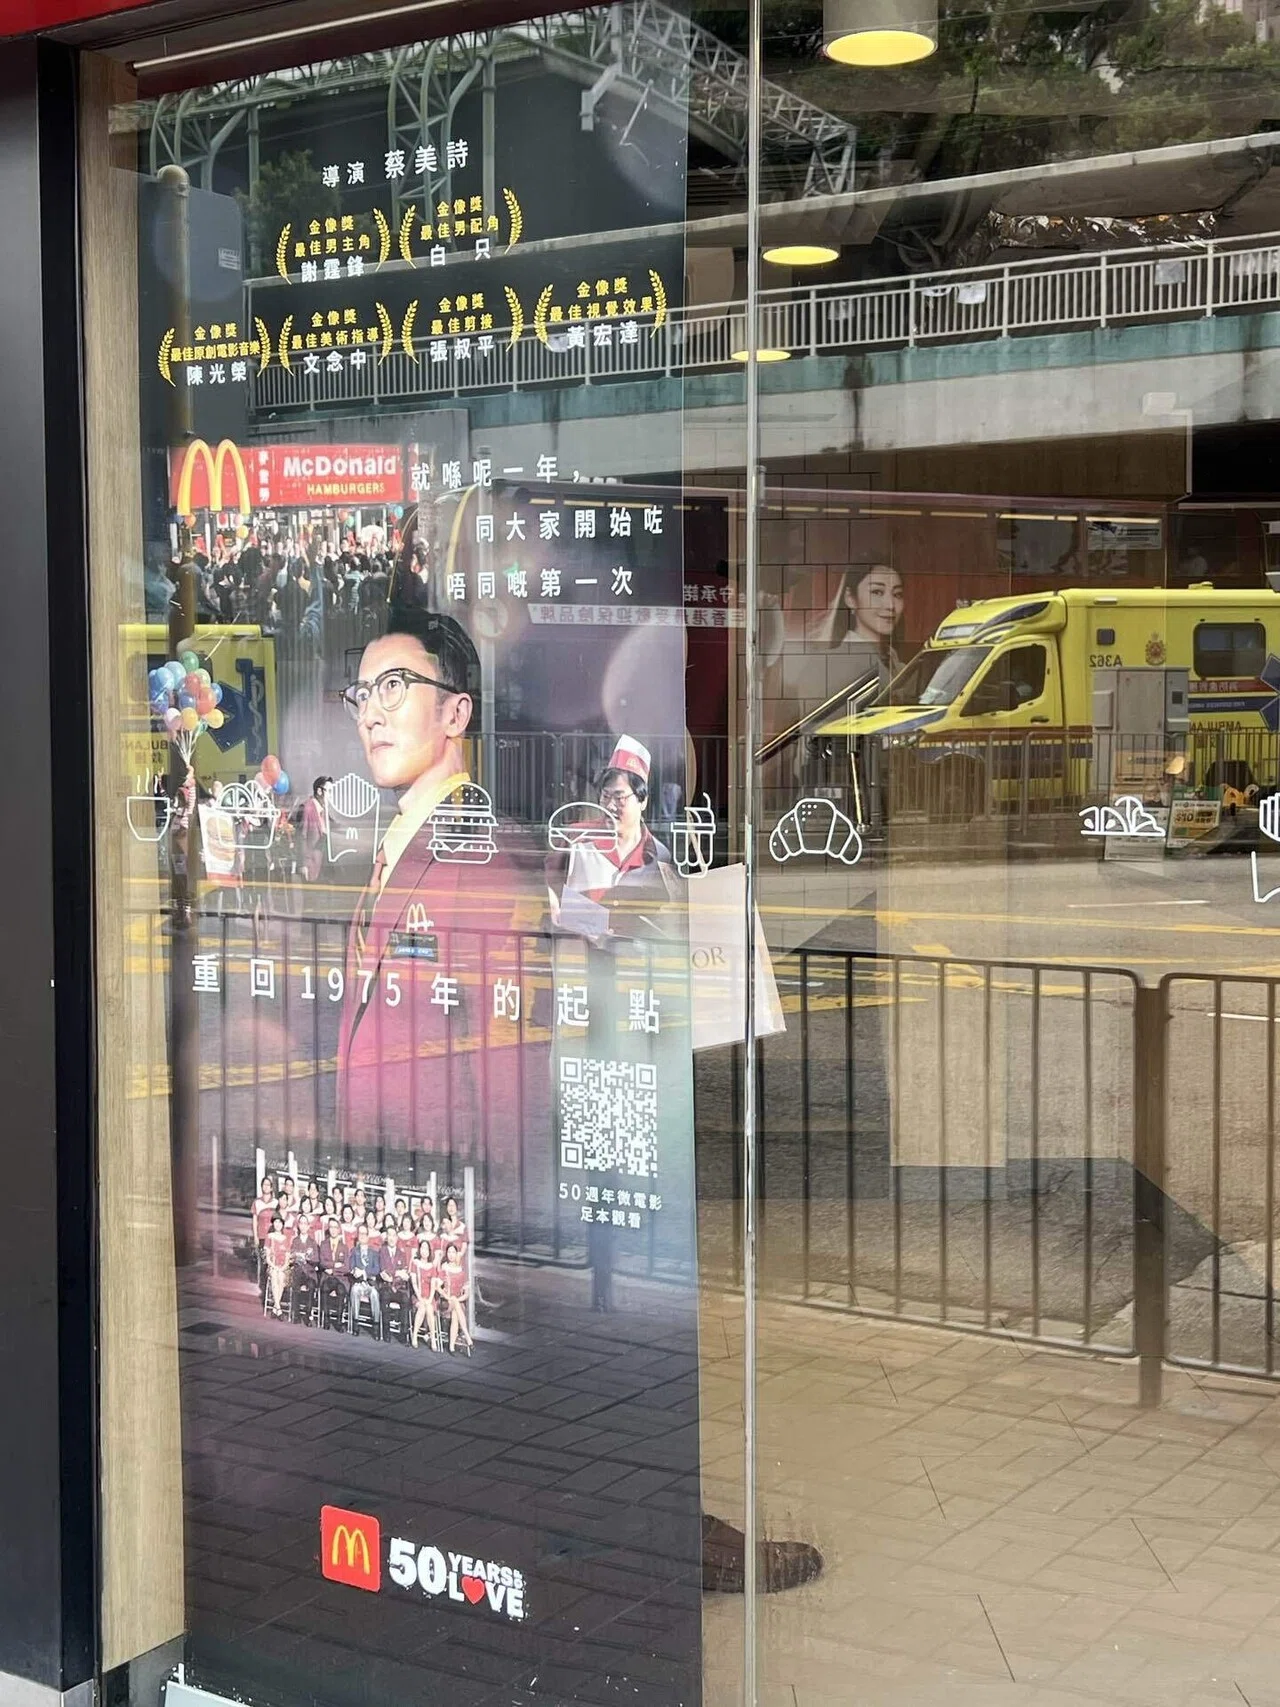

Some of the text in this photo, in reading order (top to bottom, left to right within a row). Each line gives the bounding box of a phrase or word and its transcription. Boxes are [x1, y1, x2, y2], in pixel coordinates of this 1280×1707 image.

[322, 139, 469, 188] 導演 蔡美詩
[437, 195, 482, 217] 金像獎
[309, 215, 354, 235] 金像獎
[420, 215, 499, 240] 最佳男配角
[295, 234, 370, 257] 最佳男主角
[301, 255, 364, 283] 謝霆鋒
[576, 277, 628, 298] 金像獎
[438, 293, 484, 313] 金像獎
[550, 296, 653, 322] 最佳視覺效果
[311, 308, 357, 328] 金像獎
[431, 313, 493, 335] 最佳剪接
[194, 322, 238, 341] 金像獎
[291, 327, 378, 350] 最佳美術指導
[566, 320, 639, 348] 黃宏達
[170, 340, 261, 362] 最佳原創電影音樂
[430, 335, 494, 362] 張叔平
[186, 361, 247, 386] 陳光榮
[303, 348, 367, 375] 文念中
[306, 482, 385, 495] HAMBURGERS
[476, 505, 663, 543] 同大家開始咗
[447, 566, 633, 600] 唔同嘅第一次
[191, 954, 660, 1035] 重回1975年的起點
[559, 1182, 662, 1211] 50週年微電影
[580, 1206, 641, 1229] 足本觀看
[389, 1538, 447, 1595] 50
[448, 1552, 513, 1587] YEARS
